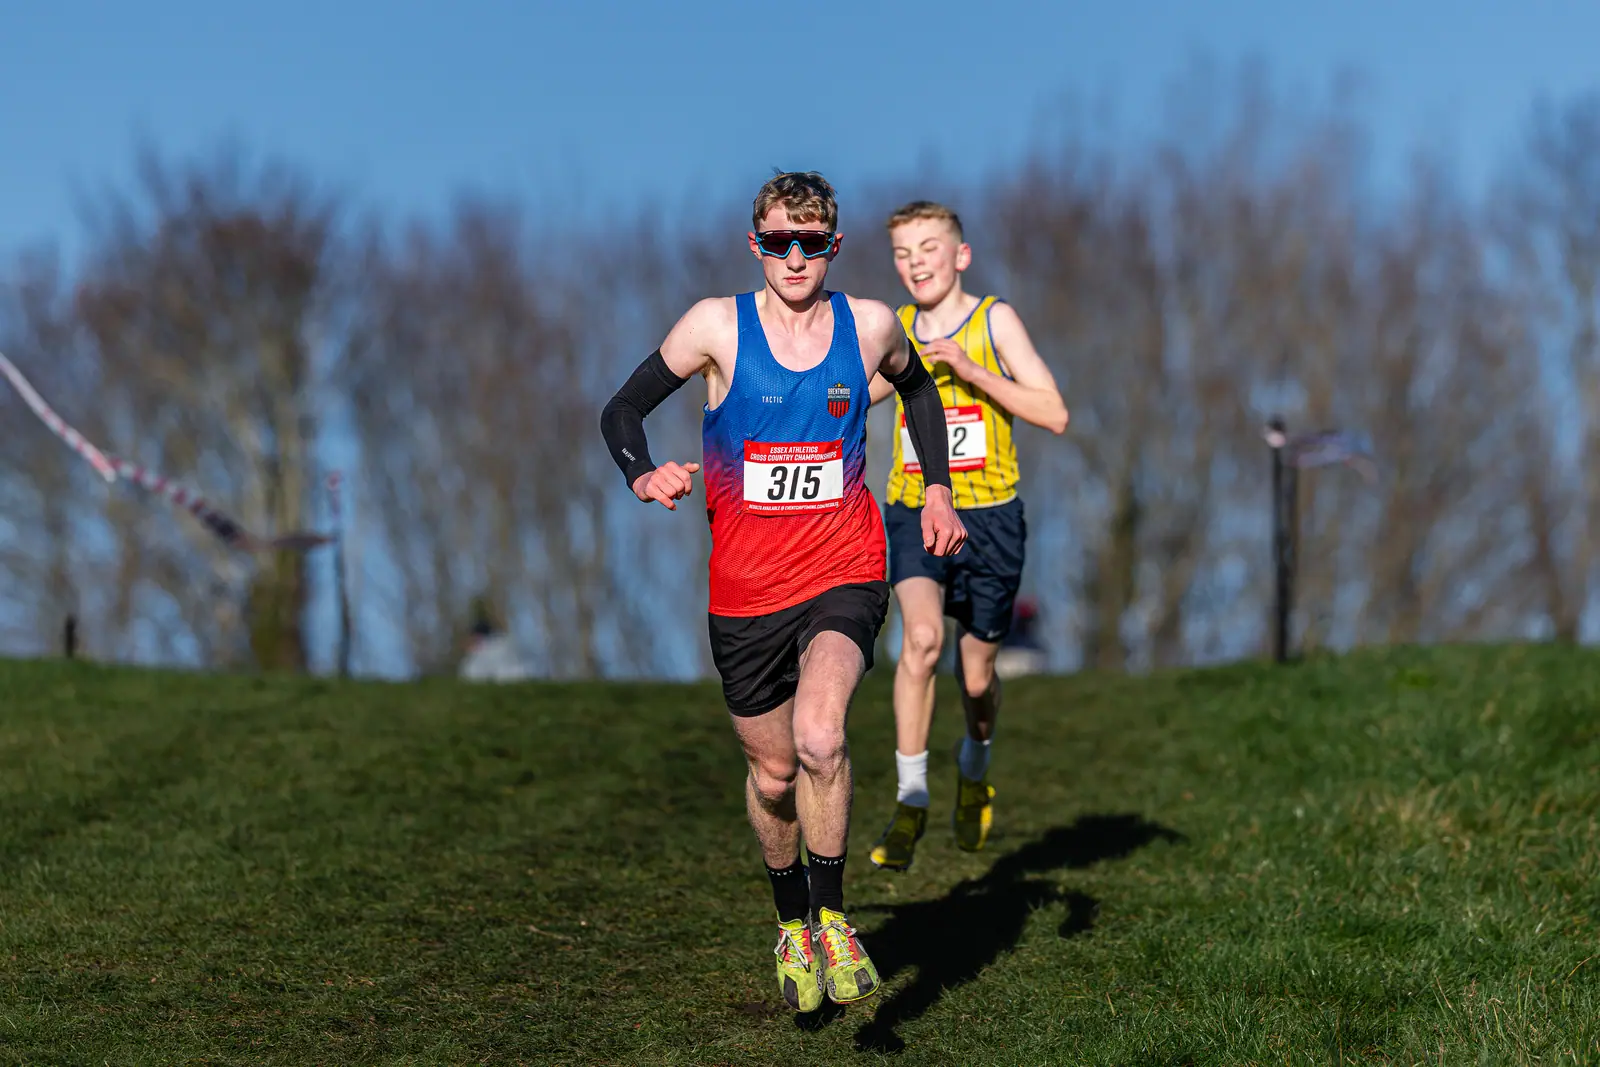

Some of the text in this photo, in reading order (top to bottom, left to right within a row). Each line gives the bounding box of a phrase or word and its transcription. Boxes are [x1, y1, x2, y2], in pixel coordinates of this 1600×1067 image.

[762, 396, 783, 404] TACTIC
[770, 446, 818, 454] ESSEX ATHLETICS
[750, 453, 767, 461] CROSS
[794, 451, 837, 461] CHAMPIONSHIPS
[767, 466, 823, 500] 315
